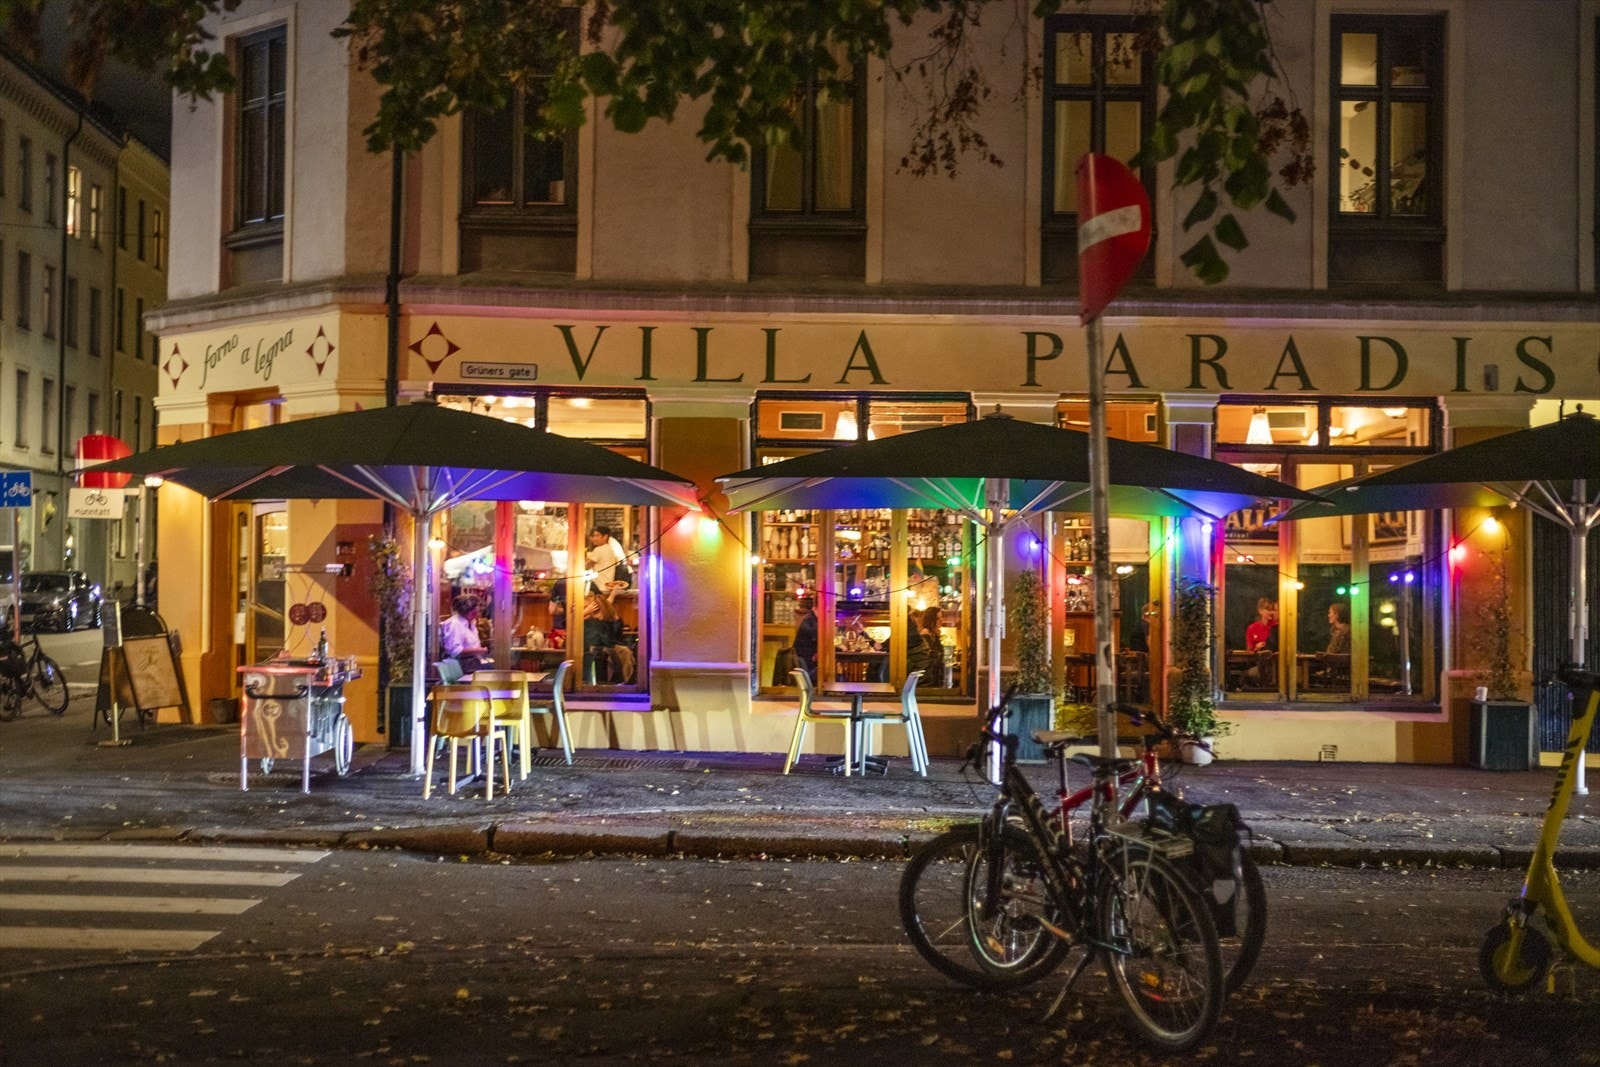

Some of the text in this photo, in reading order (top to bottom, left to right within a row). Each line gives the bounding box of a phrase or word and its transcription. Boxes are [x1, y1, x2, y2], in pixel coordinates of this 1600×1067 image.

[199, 327, 294, 390] forno a legna
[466, 365, 531, 378] Grüners gate
[553, 325, 1600, 394] VILLA PARADIS
